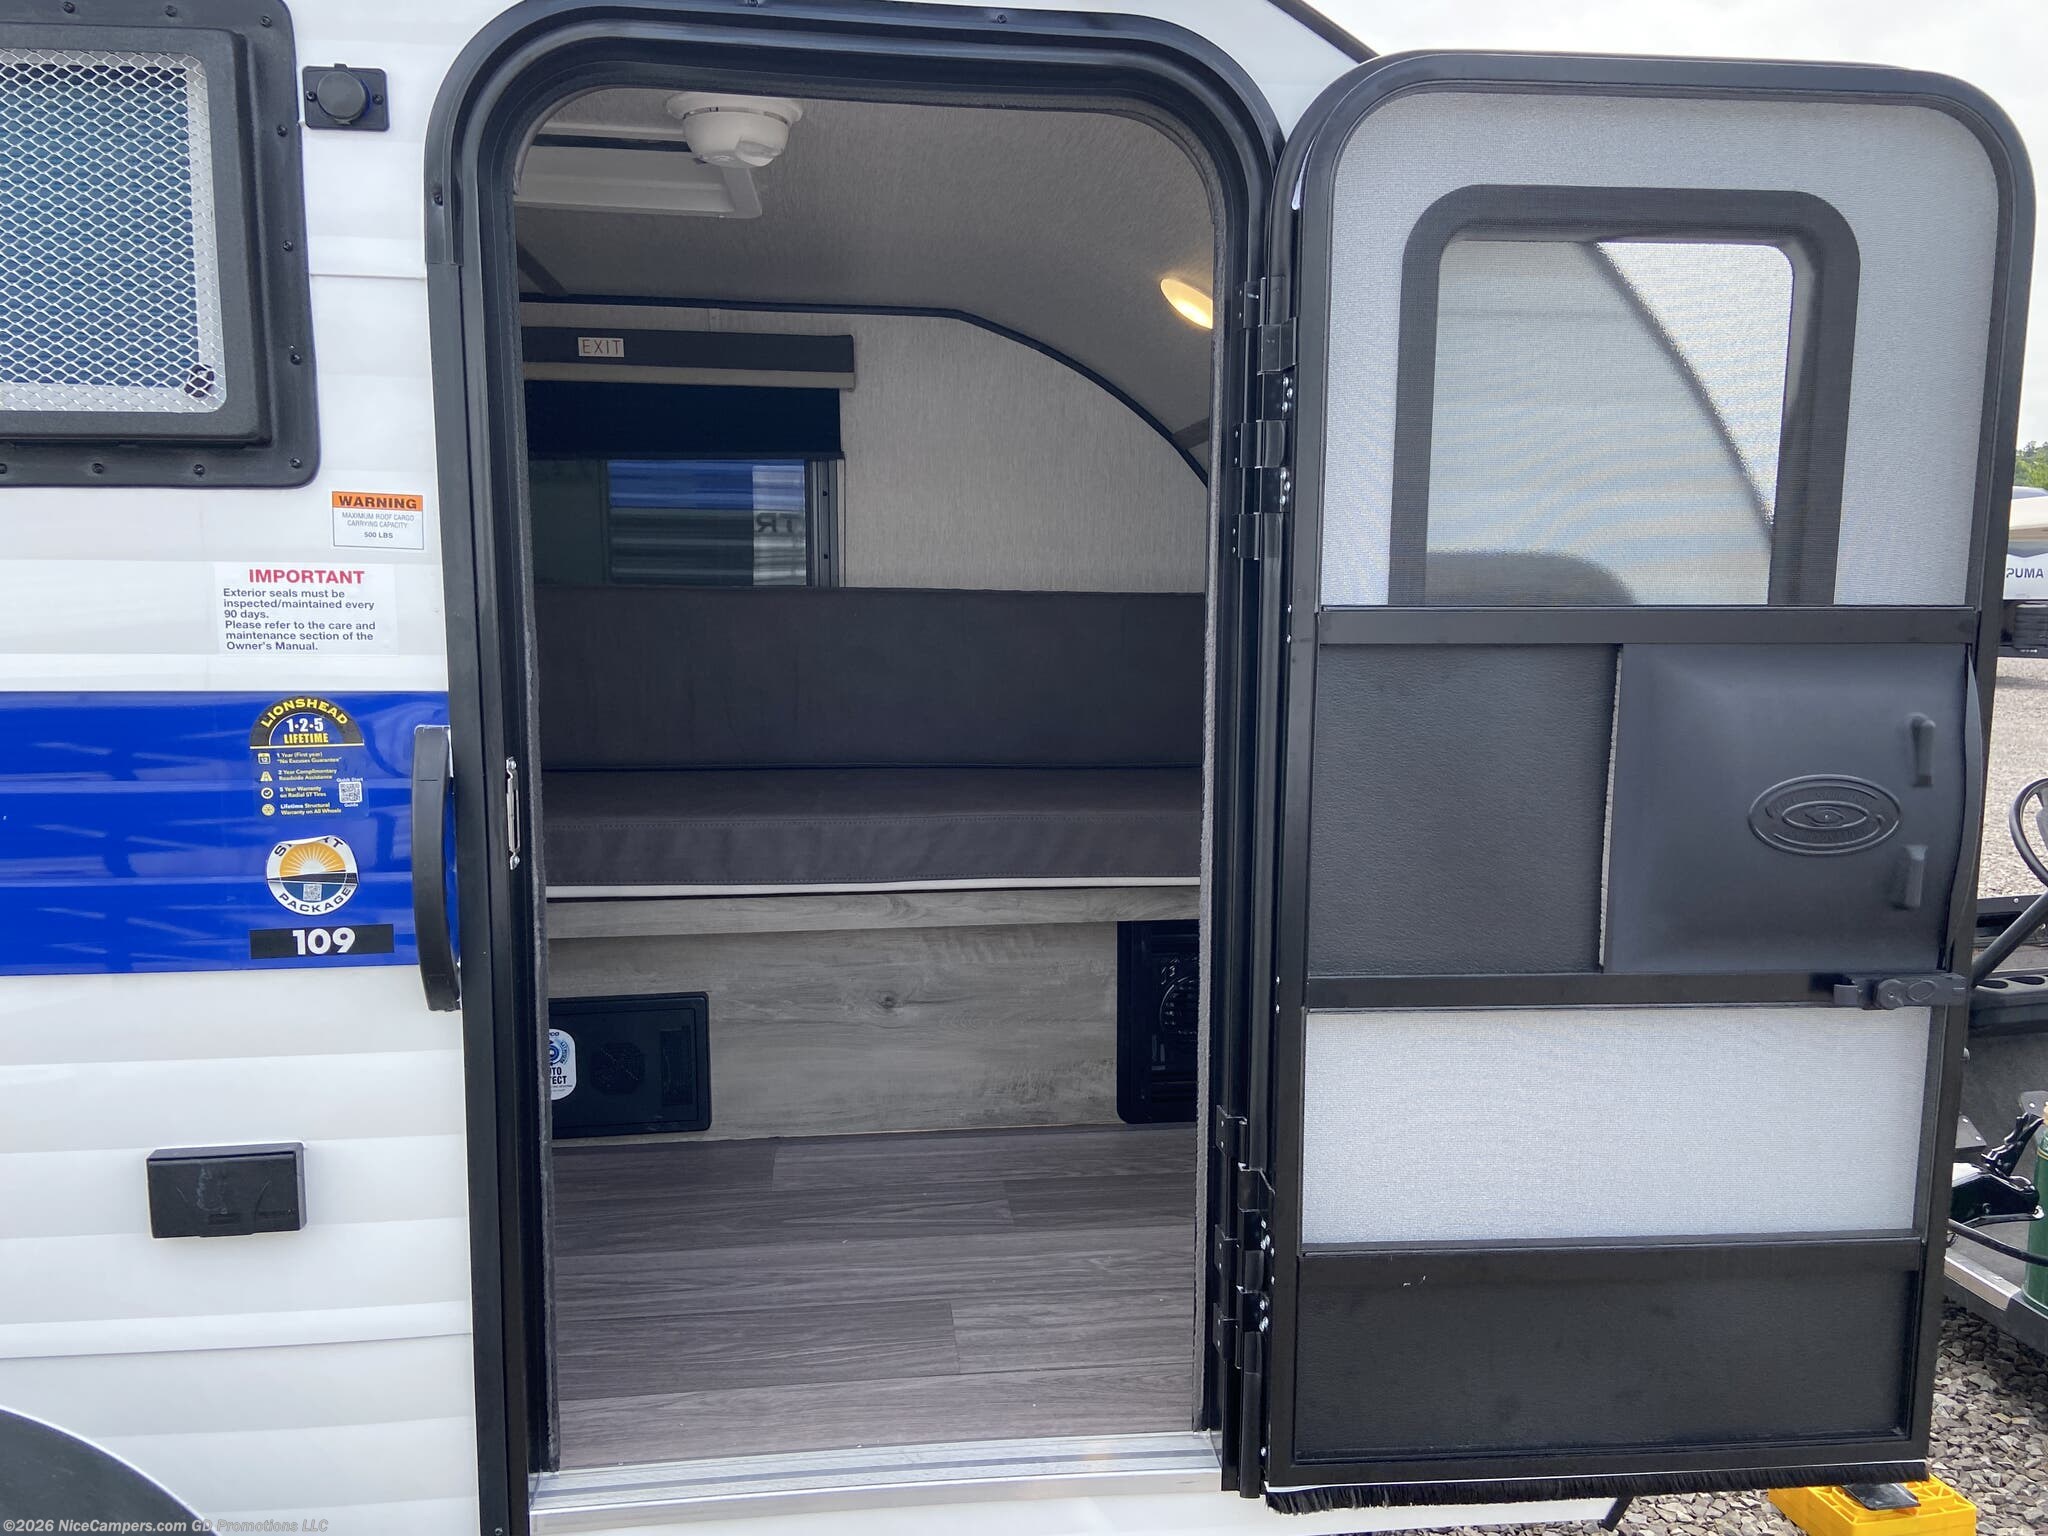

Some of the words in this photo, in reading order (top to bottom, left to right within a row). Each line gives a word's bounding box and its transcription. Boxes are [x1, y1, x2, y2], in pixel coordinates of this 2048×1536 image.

[582, 339, 622, 355] EXIT
[338, 496, 417, 509] WARNING
[342, 512, 374, 520] MAXIMUM
[375, 513, 392, 521] ROOF
[393, 514, 414, 522] CARGO
[380, 521, 408, 529] CAPACITY
[248, 569, 365, 584] IMPORTANT
[2006, 568, 2044, 578] PUMA
[223, 588, 267, 598] Exterior
[269, 588, 298, 598] seals
[301, 589, 329, 598] must
[331, 589, 345, 598] be
[223, 599, 342, 611] inspected/maintained
[345, 601, 375, 611] every
[224, 610, 238, 618] 90
[240, 609, 269, 621] days.
[225, 620, 262, 630] Please
[264, 620, 291, 630] refer
[293, 621, 305, 630] to
[308, 621, 325, 630] the
[328, 622, 353, 630] care
[355, 621, 376, 630] and
[225, 631, 297, 640] maintenance
[299, 631, 340, 641] section
[342, 631, 354, 641] of
[356, 631, 374, 641] the
[226, 641, 272, 650] Owner's
[275, 641, 319, 651] Manual.
[260, 698, 348, 728] LIONSHEAD
[284, 732, 329, 744] LIFETIME
[279, 886, 351, 913] PACKAGE
[292, 927, 356, 955] 109
